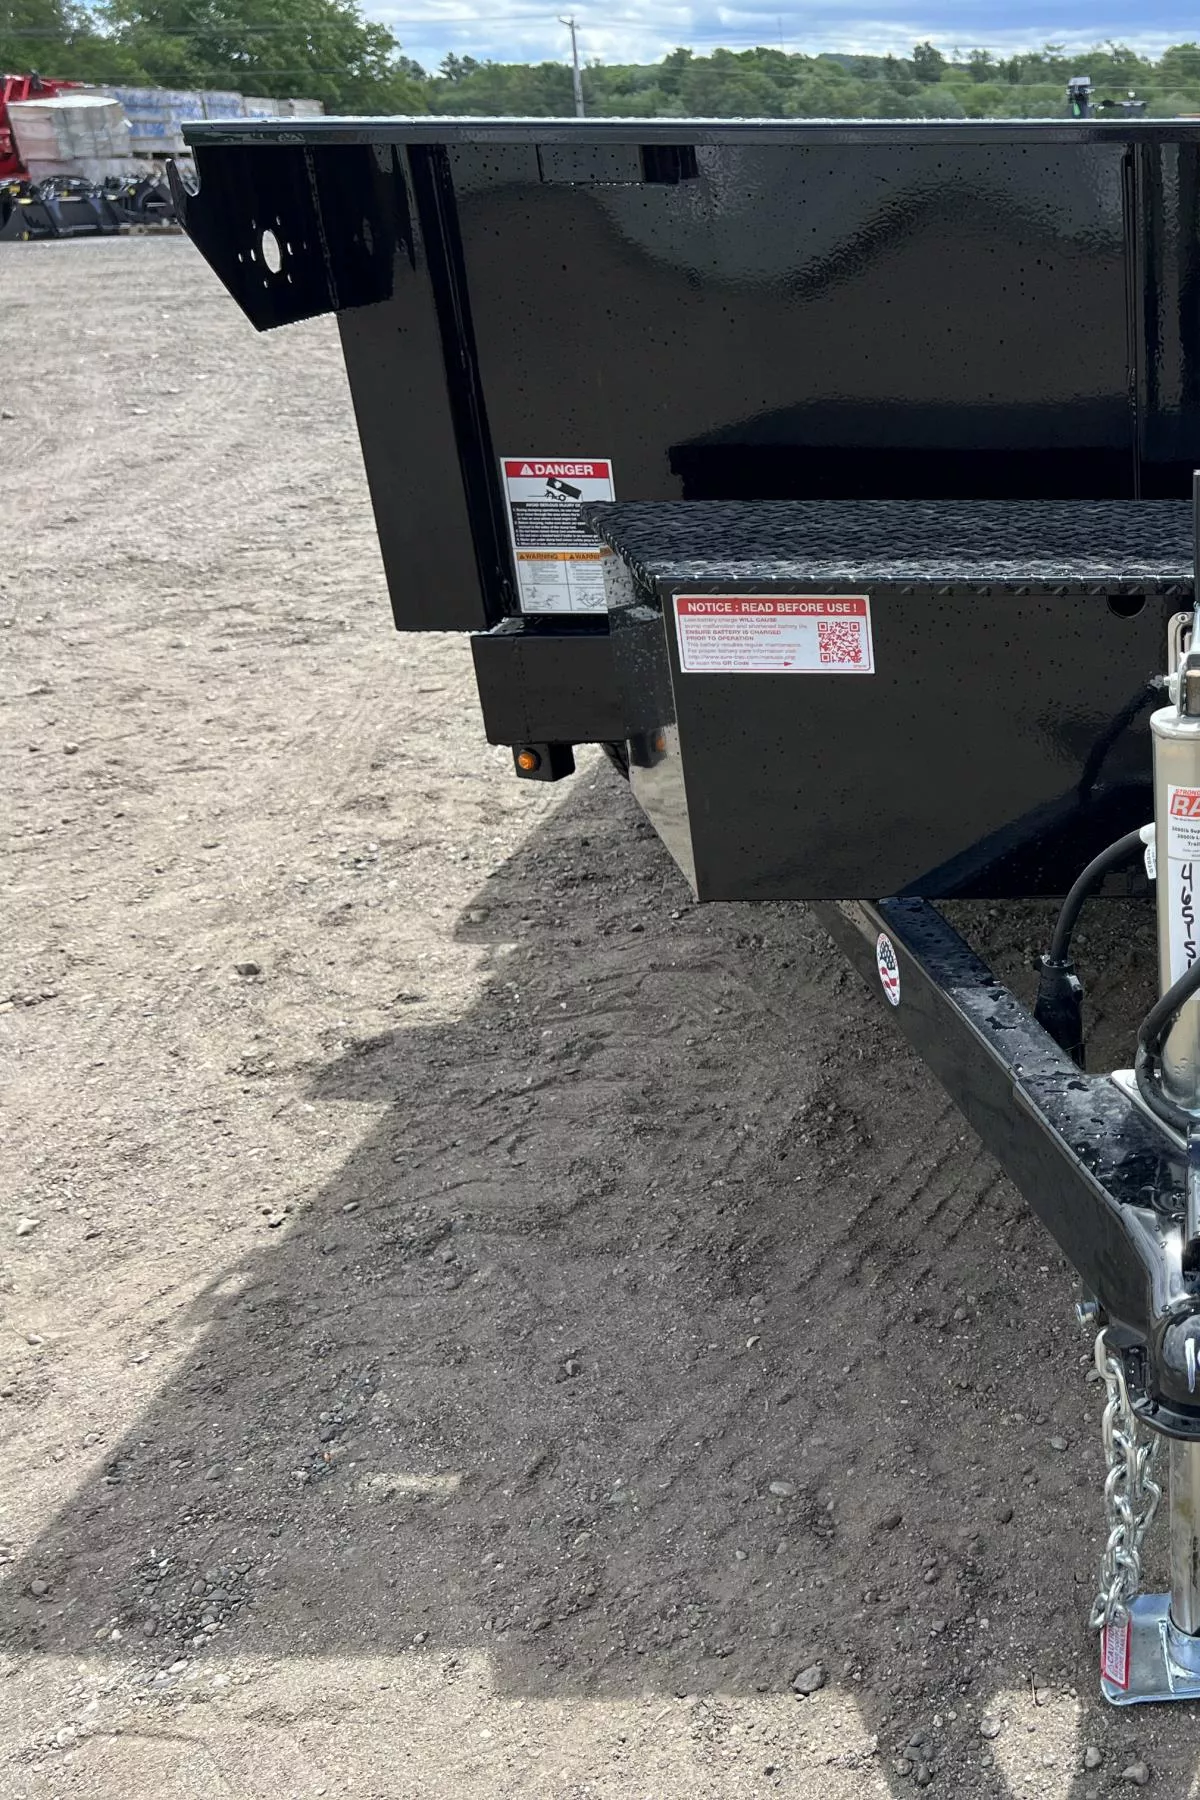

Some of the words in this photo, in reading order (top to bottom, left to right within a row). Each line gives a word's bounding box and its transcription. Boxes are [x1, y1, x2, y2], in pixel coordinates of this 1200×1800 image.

[535, 464, 594, 475] DANGER
[687, 602, 732, 612] NOTICE
[742, 602, 774, 612] READ
[777, 602, 824, 612] BEFORE
[827, 602, 850, 612] USE
